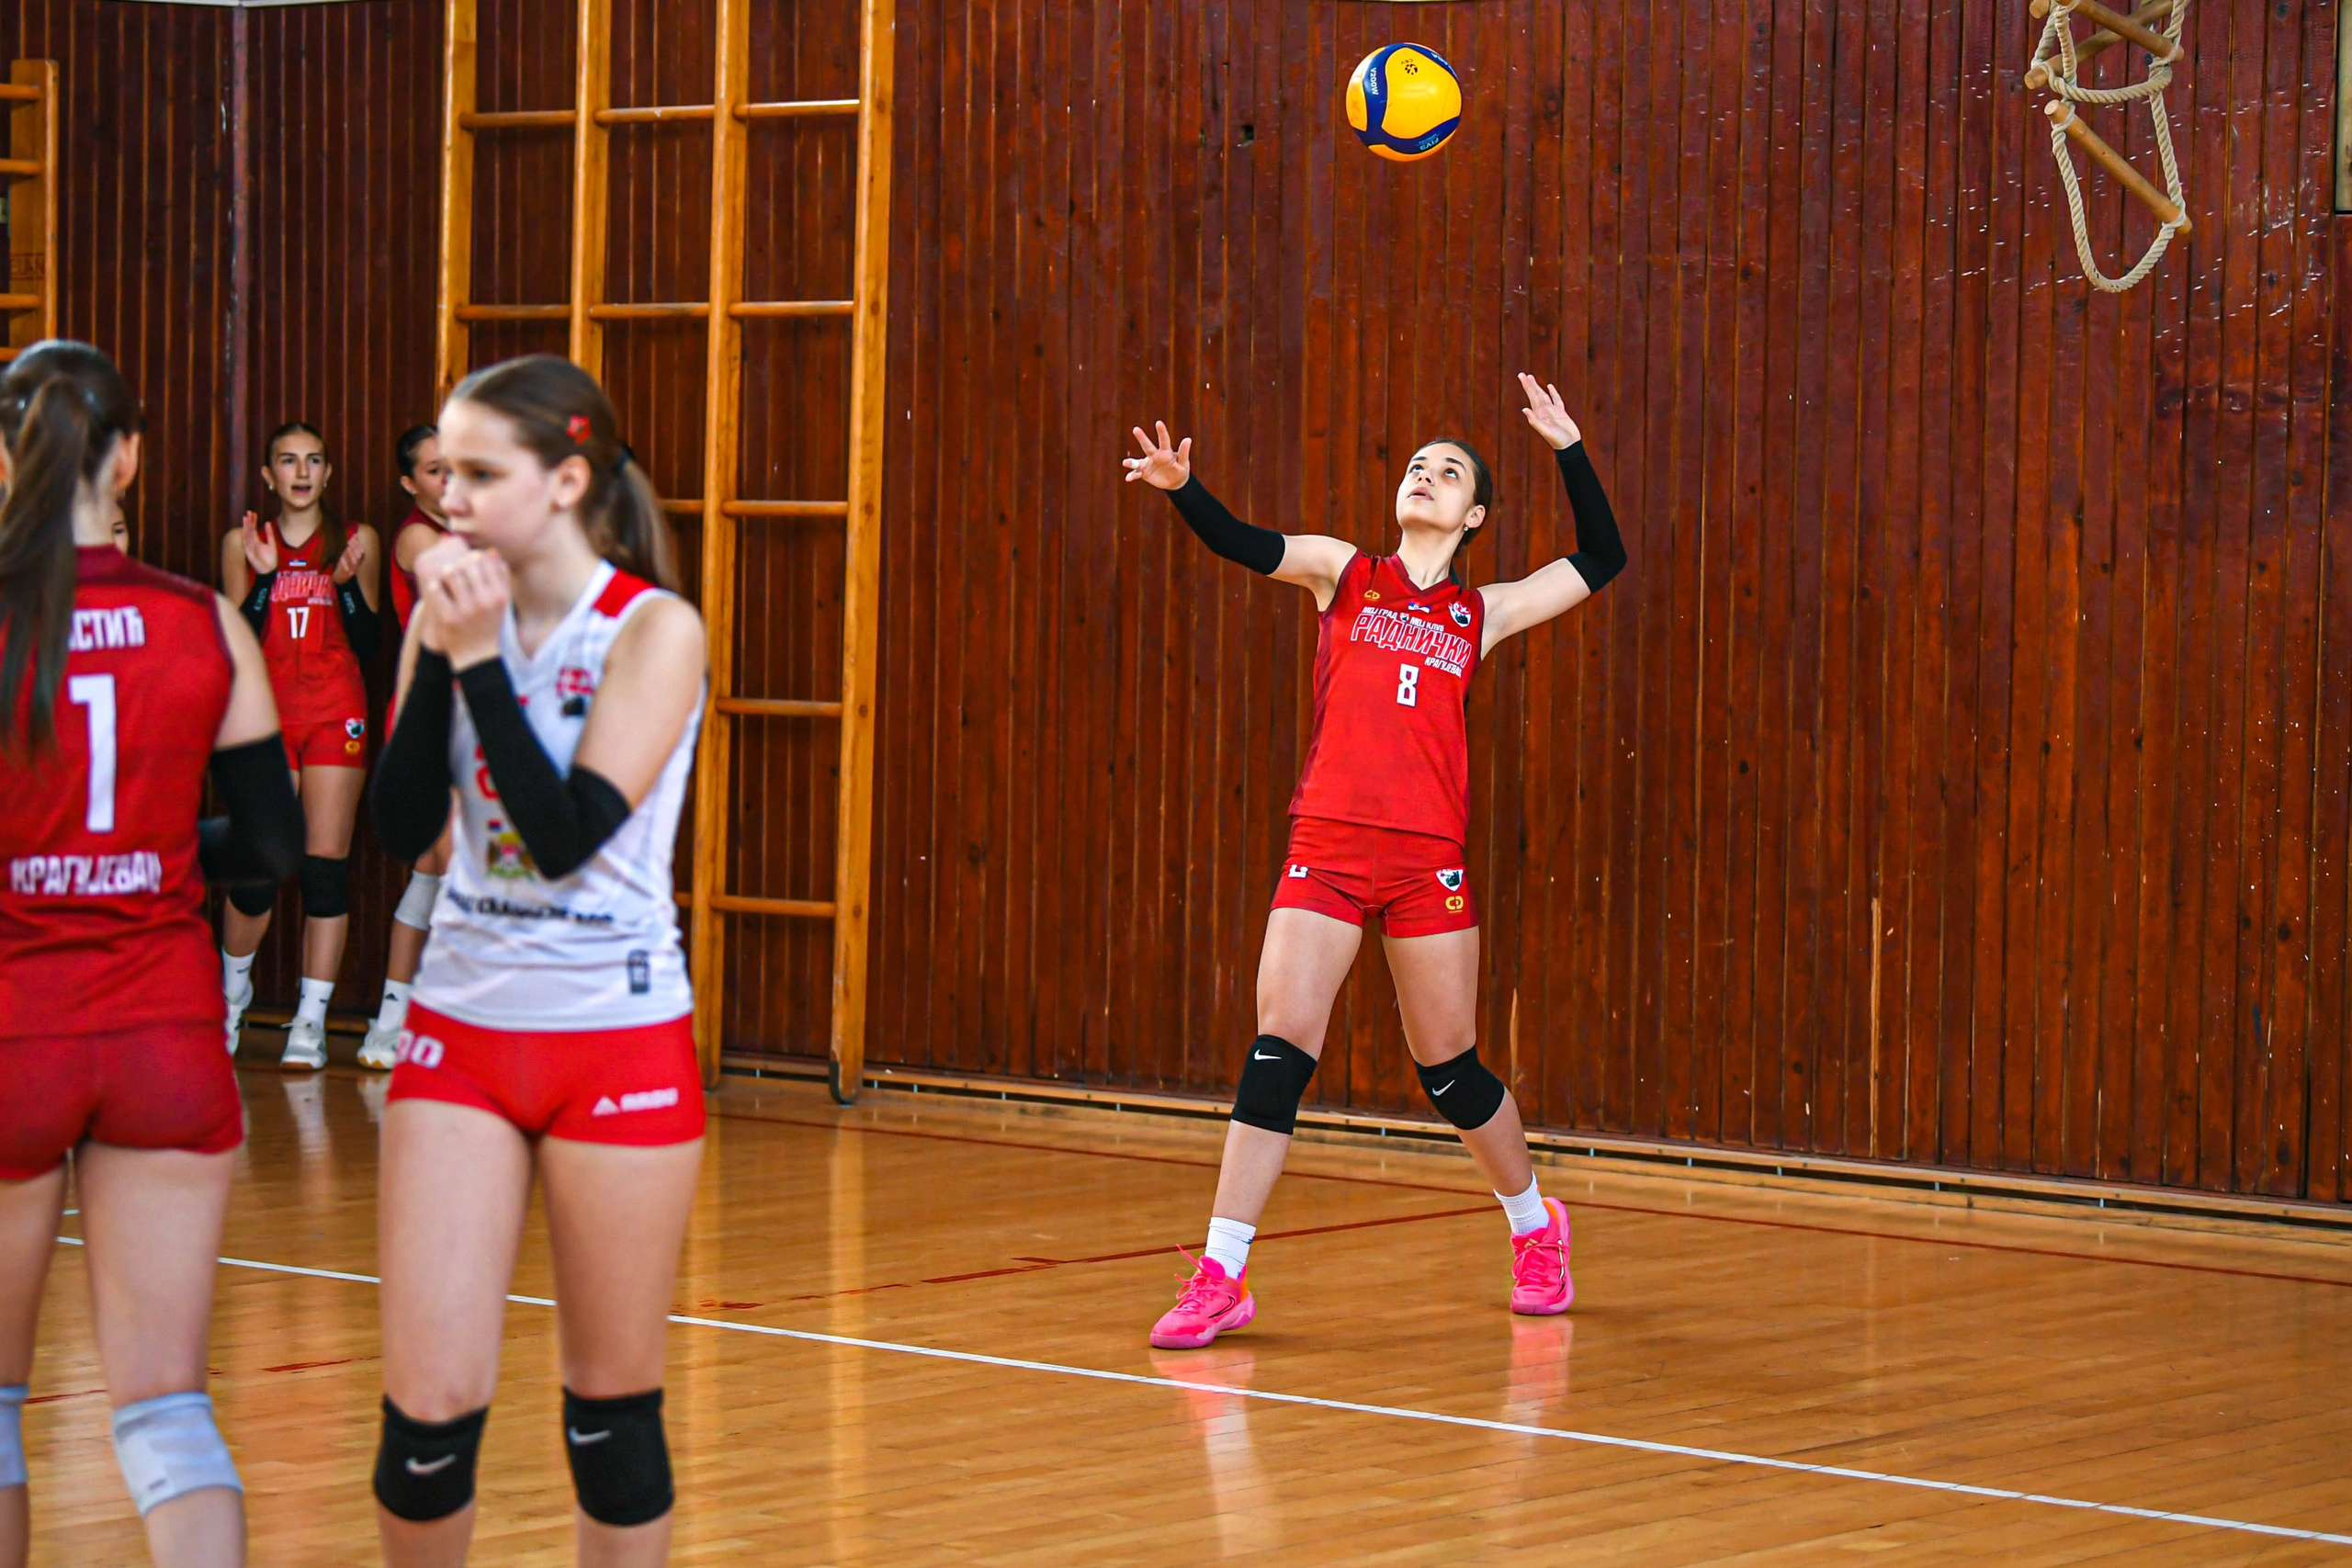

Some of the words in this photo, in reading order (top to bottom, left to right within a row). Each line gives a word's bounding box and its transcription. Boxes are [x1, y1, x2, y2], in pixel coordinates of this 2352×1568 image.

[1370, 67, 1379, 96] V200W
[68, 606, 145, 651] СТИЋ
[287, 606, 310, 639] 17
[1351, 614, 1472, 668] РАДНИЧКИ
[1362, 606, 1378, 615] МОЈ
[1378, 608, 1398, 620] ГРАД
[1409, 616, 1426, 628] МОЈ
[1426, 621, 1445, 632] КЛУБ
[1396, 663, 1419, 707] 8
[68, 673, 116, 832] 1
